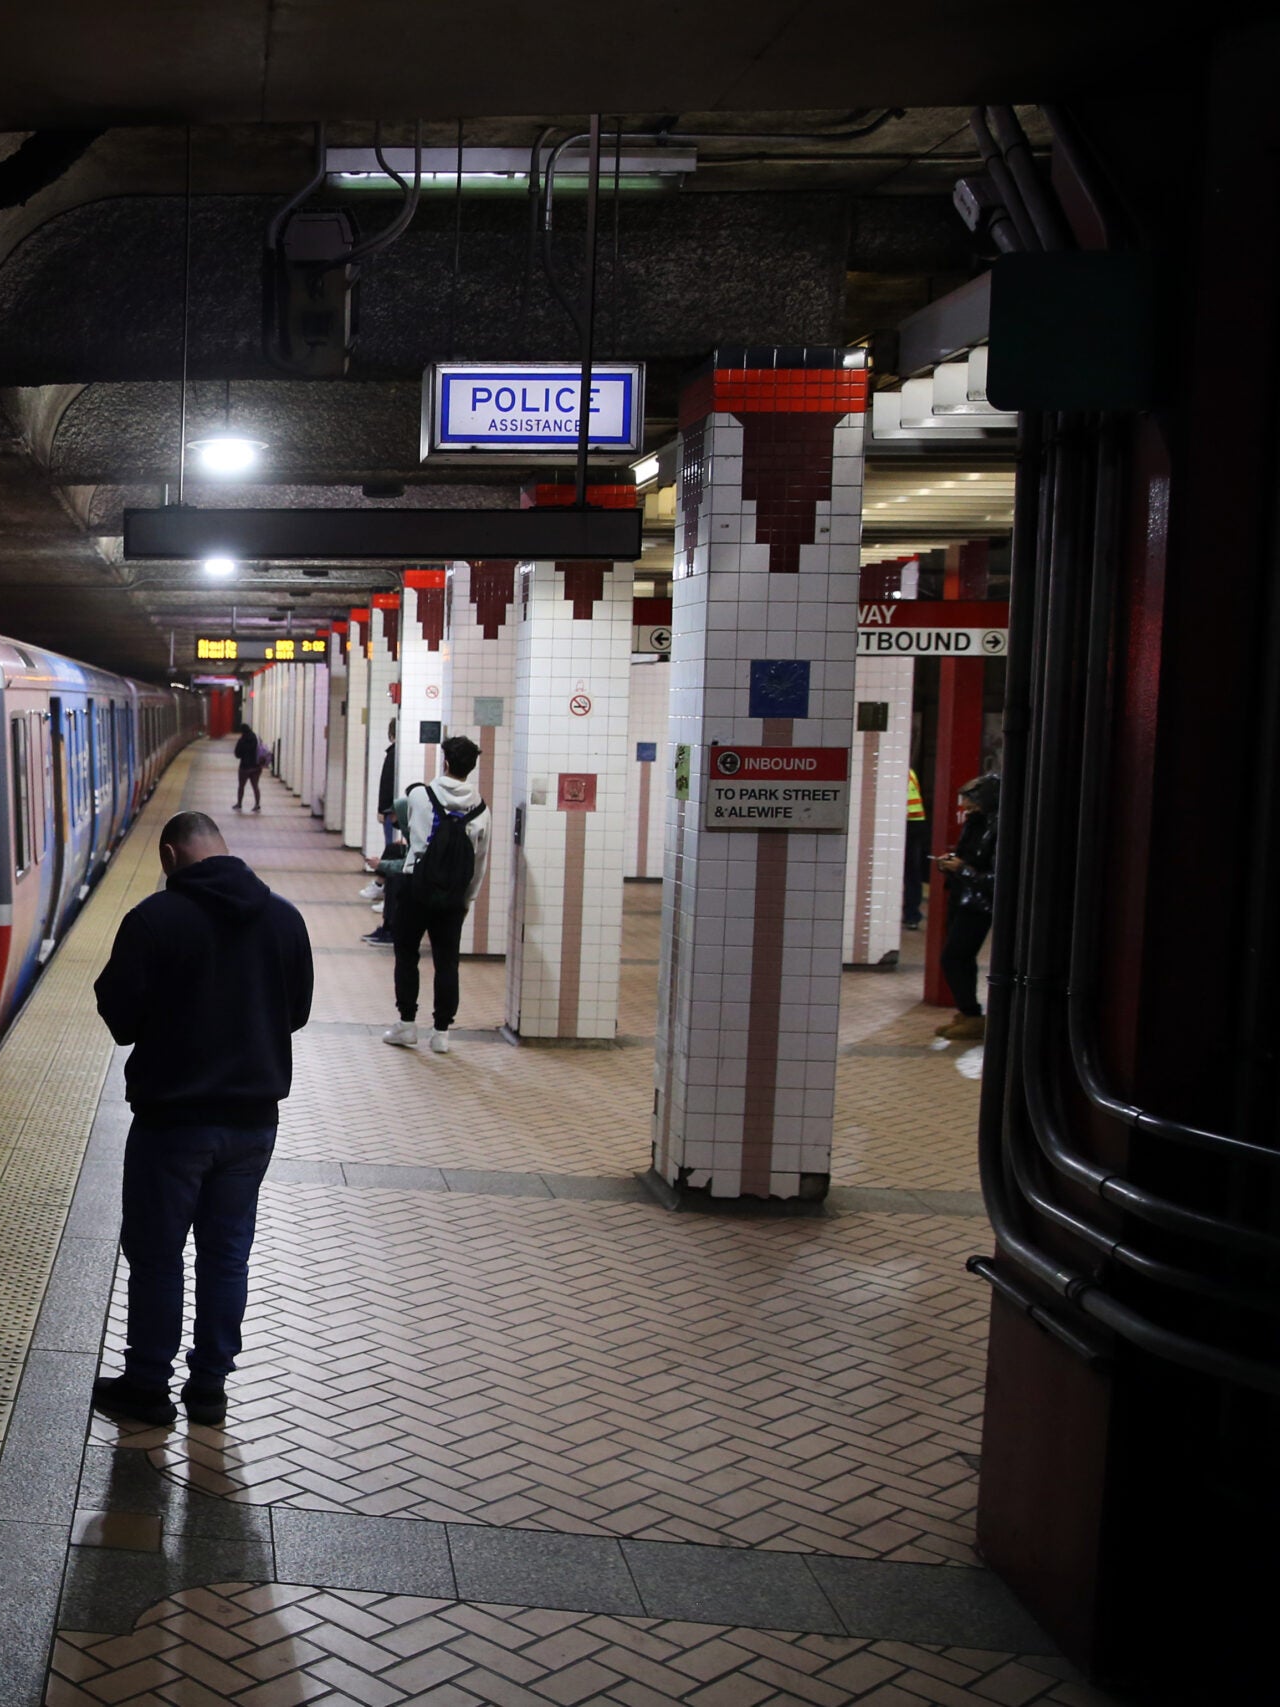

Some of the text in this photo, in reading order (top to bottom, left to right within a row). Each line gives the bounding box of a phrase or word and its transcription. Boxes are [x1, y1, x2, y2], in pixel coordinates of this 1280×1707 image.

[472, 387, 600, 413] POLICE
[488, 418, 581, 433] ASSISTANCE
[302, 641, 325, 652] 2:02
[857, 632, 971, 651] TBOUND
[744, 757, 818, 771] INBOUND
[715, 788, 840, 801] TO PARK STREET
[714, 806, 793, 818] & ALEWIFE
